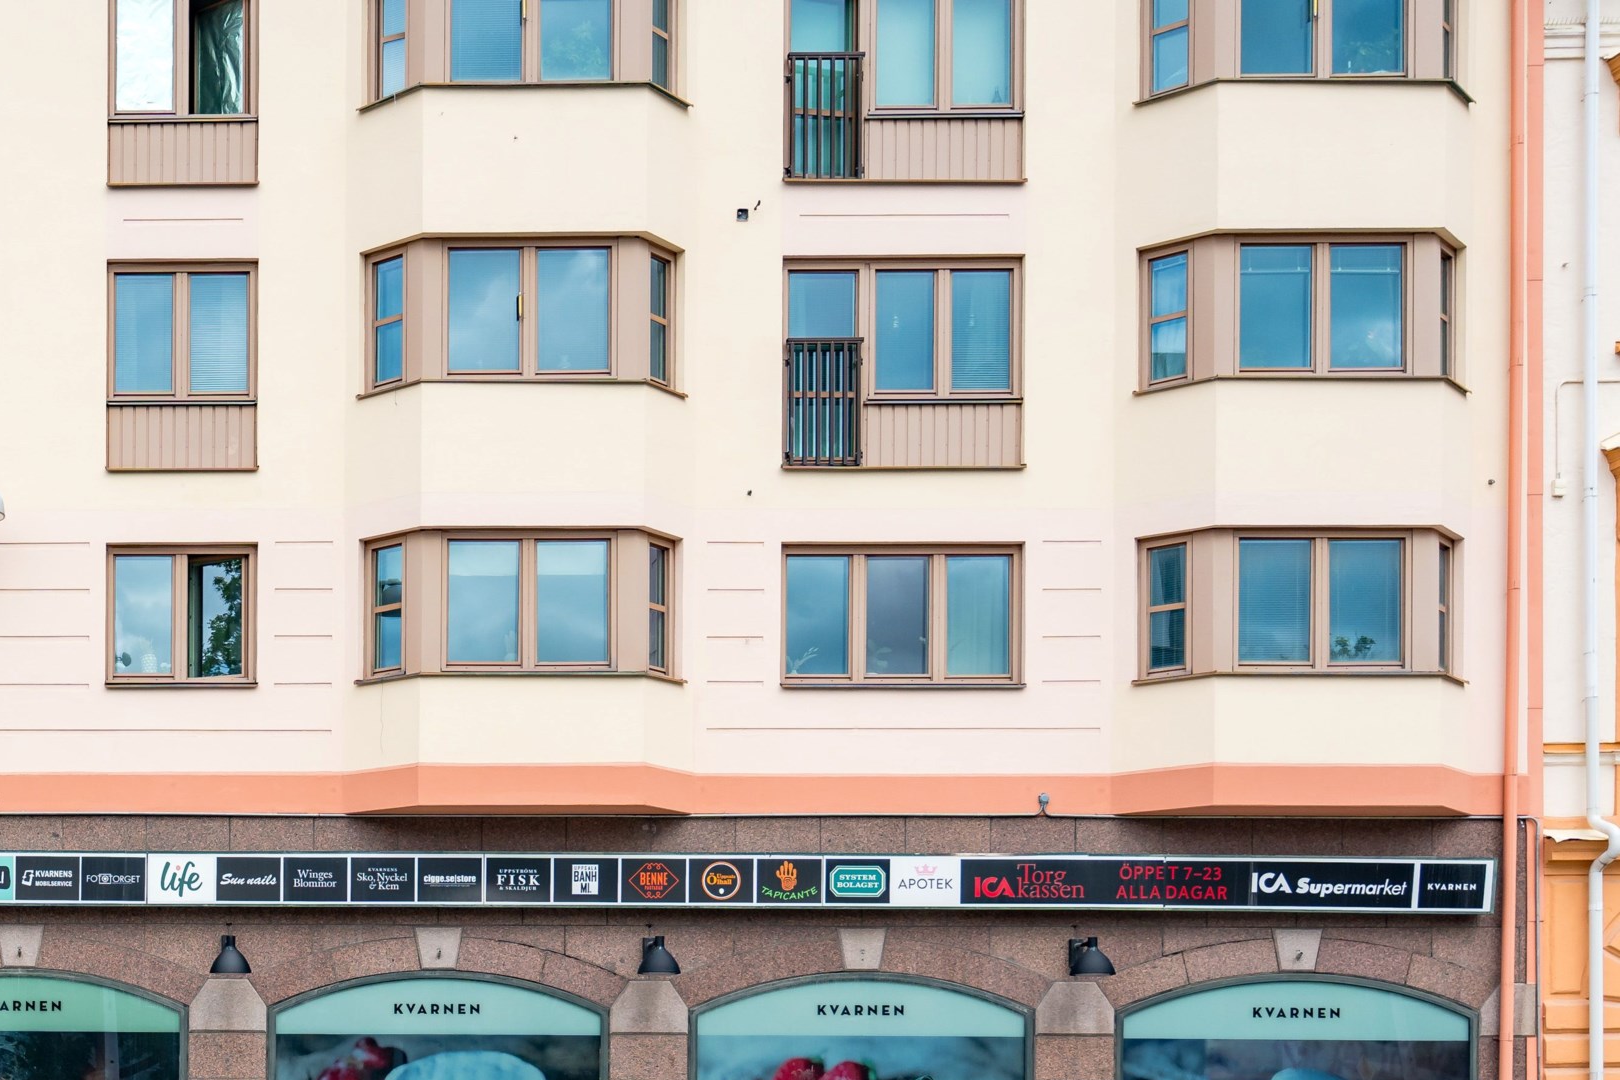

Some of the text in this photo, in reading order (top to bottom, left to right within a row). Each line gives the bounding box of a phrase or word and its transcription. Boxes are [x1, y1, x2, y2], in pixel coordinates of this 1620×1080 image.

[35, 870, 72, 878] KVARNENS
[297, 869, 333, 880] Winges
[574, 871, 597, 882] BANH
[1017, 864, 1066, 886] Torg
[1119, 863, 1178, 880] ÖPPET
[161, 861, 202, 897] life
[220, 873, 277, 885] Sun nails
[293, 878, 337, 888] Blommor
[356, 872, 408, 883] Sko, Nyckel
[496, 874, 540, 886] FISK
[640, 872, 668, 886] BENNE
[369, 882, 399, 890] & Kem
[898, 879, 953, 889] APOTEK
[974, 876, 1015, 898] ICA
[1017, 881, 1084, 898] kassen
[1251, 872, 1407, 897] ICA Supermarket
[1427, 883, 1477, 891] KVARNEN
[761, 886, 818, 900] TAPICANTE
[1116, 885, 1227, 900] ALLA DAGAR
[394, 1004, 480, 1014] KVARNEN
[817, 1005, 904, 1015] KVARNEN
[1253, 1007, 1340, 1018] KVARNEN
